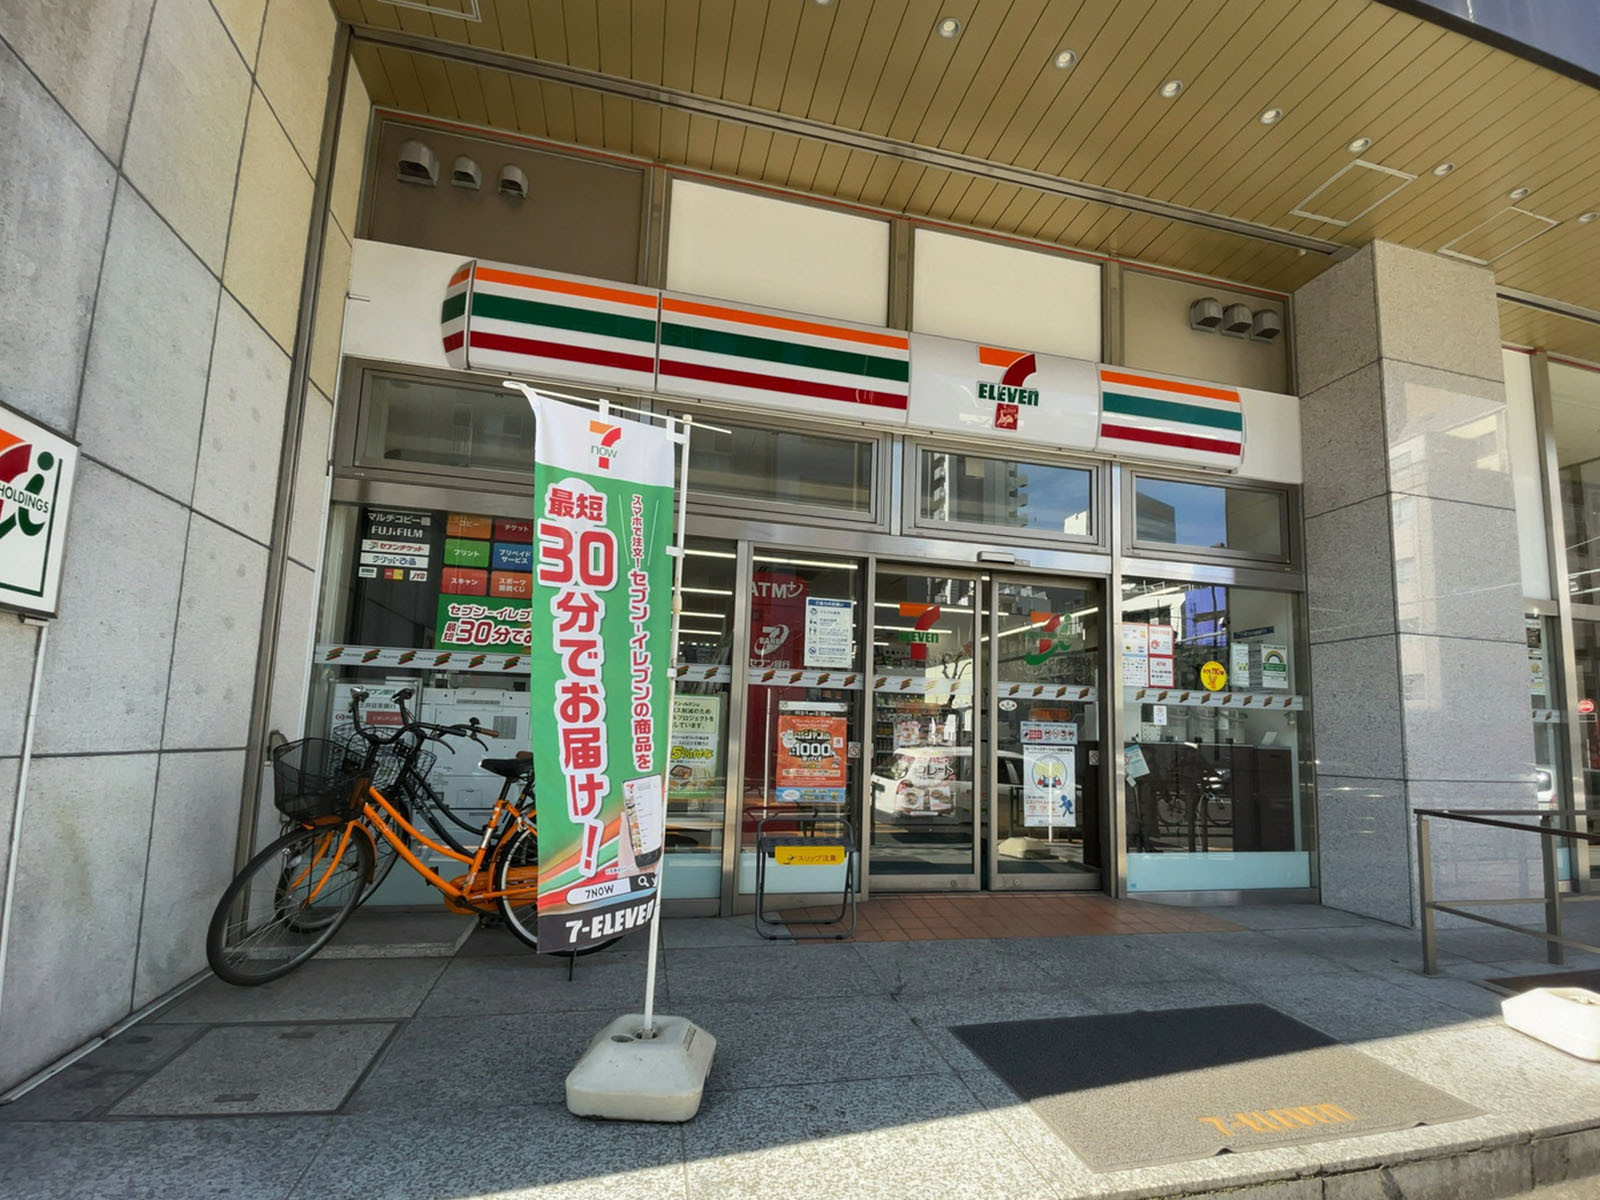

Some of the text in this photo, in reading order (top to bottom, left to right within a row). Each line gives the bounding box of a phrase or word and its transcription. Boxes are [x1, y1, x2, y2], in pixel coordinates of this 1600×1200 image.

[591, 445, 618, 458] now
[548, 487, 604, 523] 最短
[459, 520, 481, 528] コピー
[504, 523, 529, 532] チケット
[371, 525, 423, 538] FUJIFILM
[454, 548, 481, 558] プリント
[499, 549, 531, 558] プリペイド
[540, 523, 614, 587] 30
[502, 557, 529, 565] サービス
[451, 577, 478, 586] スキャン
[499, 578, 527, 586] スポーツ
[751, 582, 787, 598] ATM
[899, 630, 939, 643] EVEn
[585, 885, 615, 899] 7NOW
